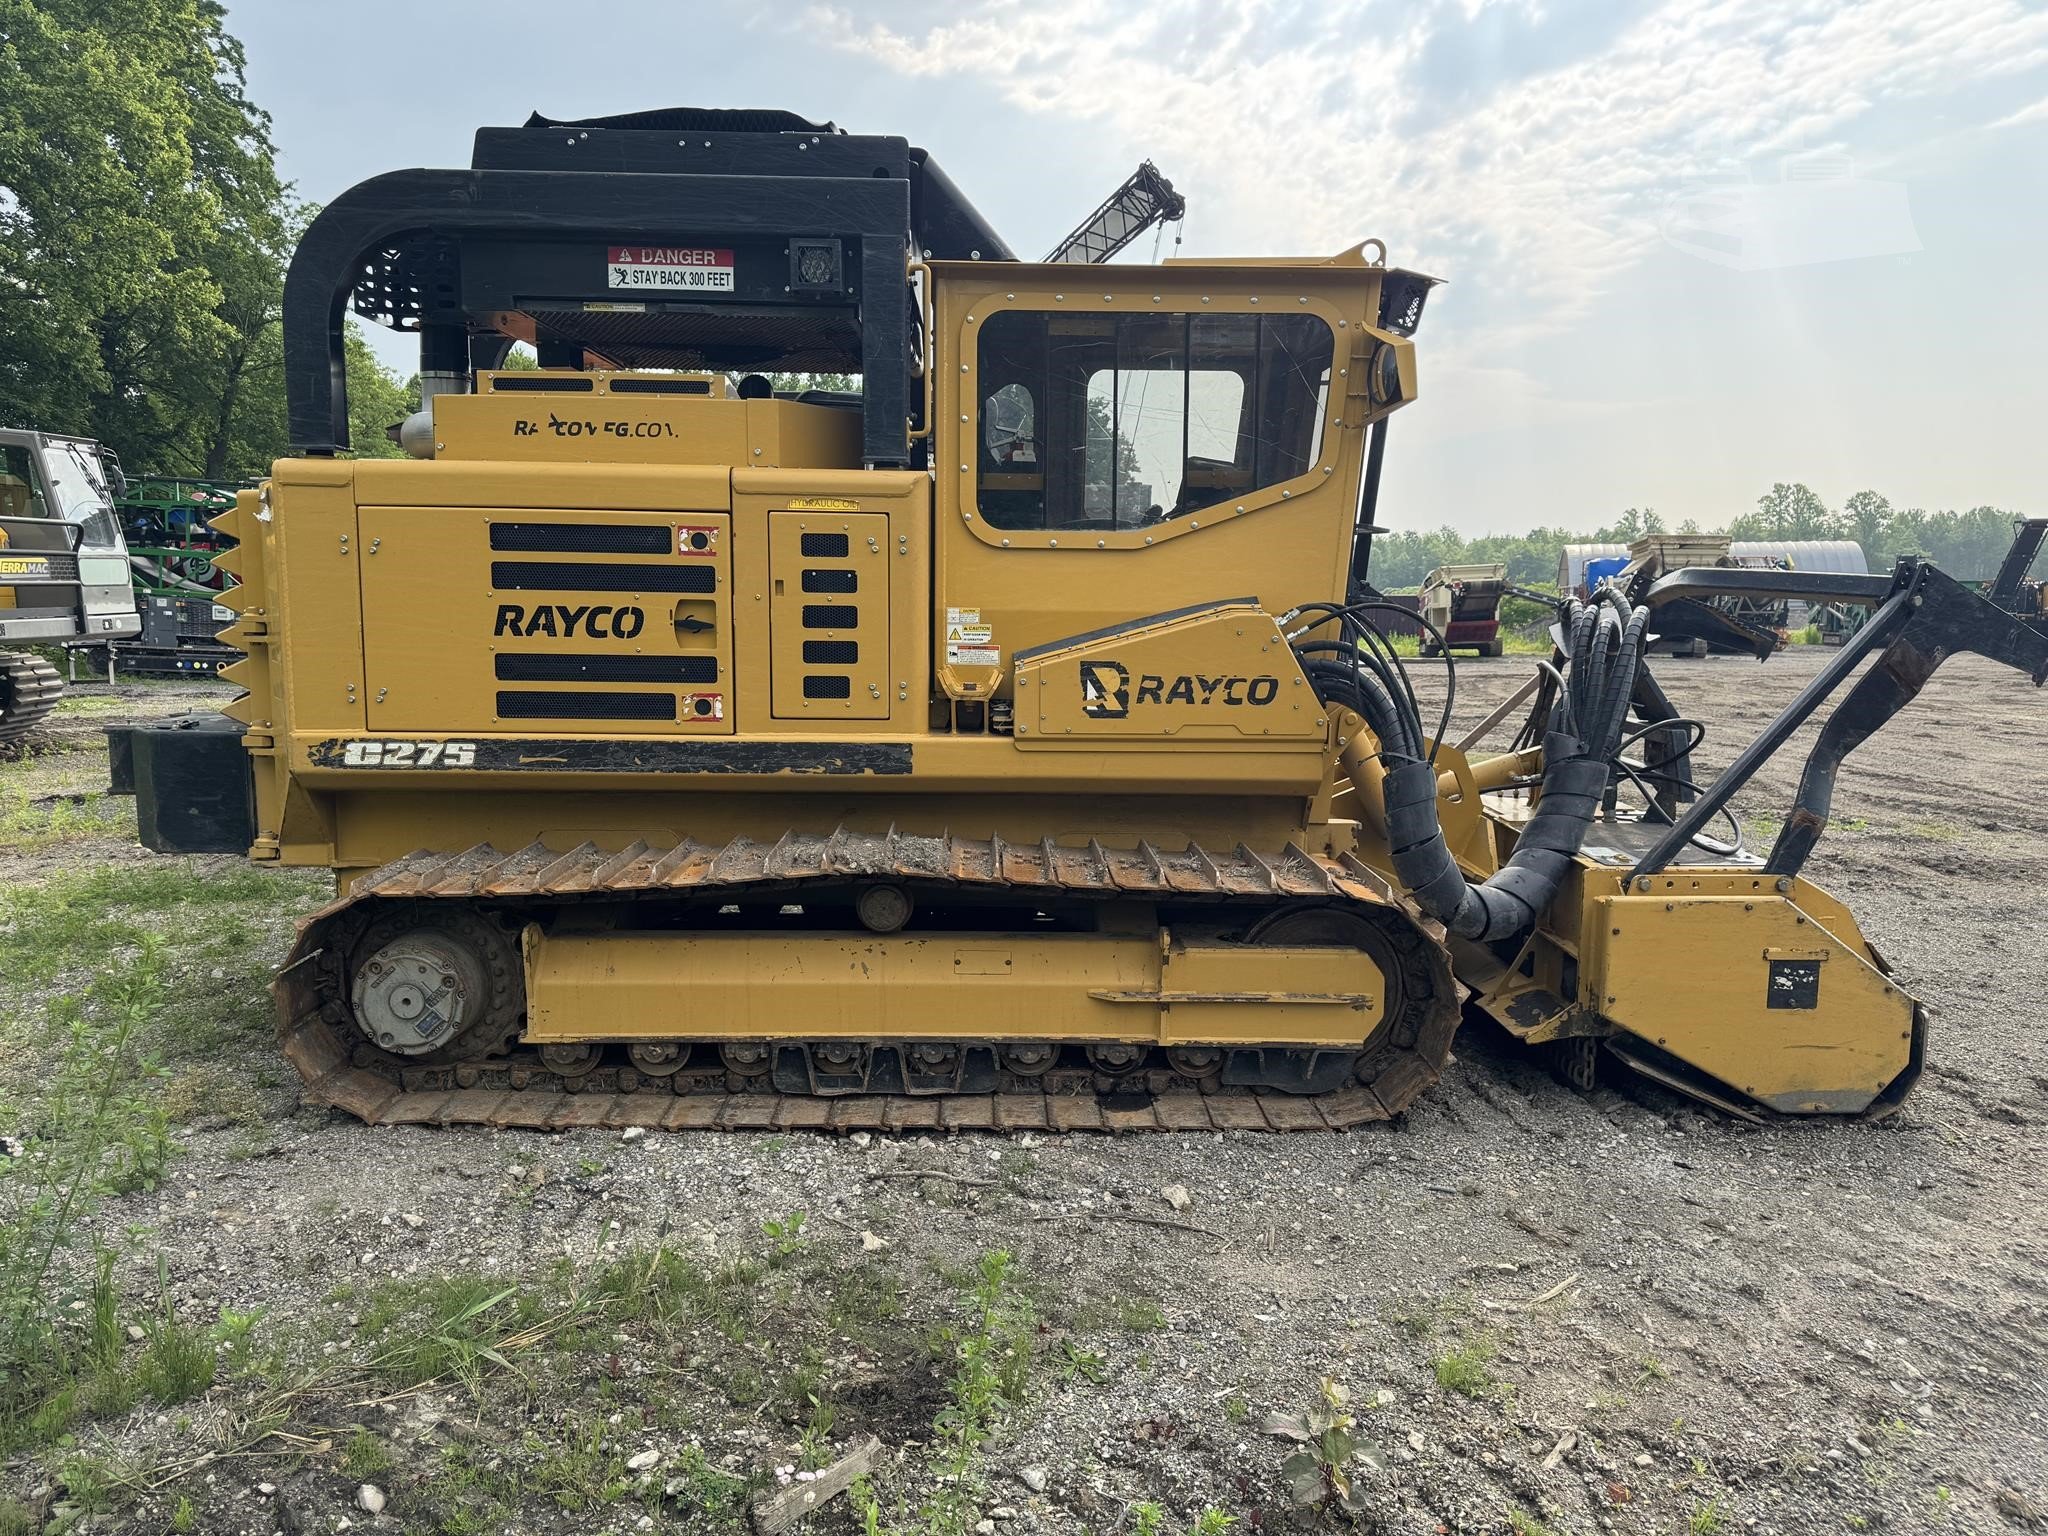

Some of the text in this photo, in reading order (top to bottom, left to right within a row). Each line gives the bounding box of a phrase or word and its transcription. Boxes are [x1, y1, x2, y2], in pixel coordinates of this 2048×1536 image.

[641, 249, 716, 265] DANGER
[632, 270, 731, 287] STAY BACK 300 FEET
[0, 562, 49, 574] ERRAMAC
[494, 604, 645, 640] RAYCO
[1136, 674, 1279, 706] RAYCO
[344, 743, 476, 765] C275
